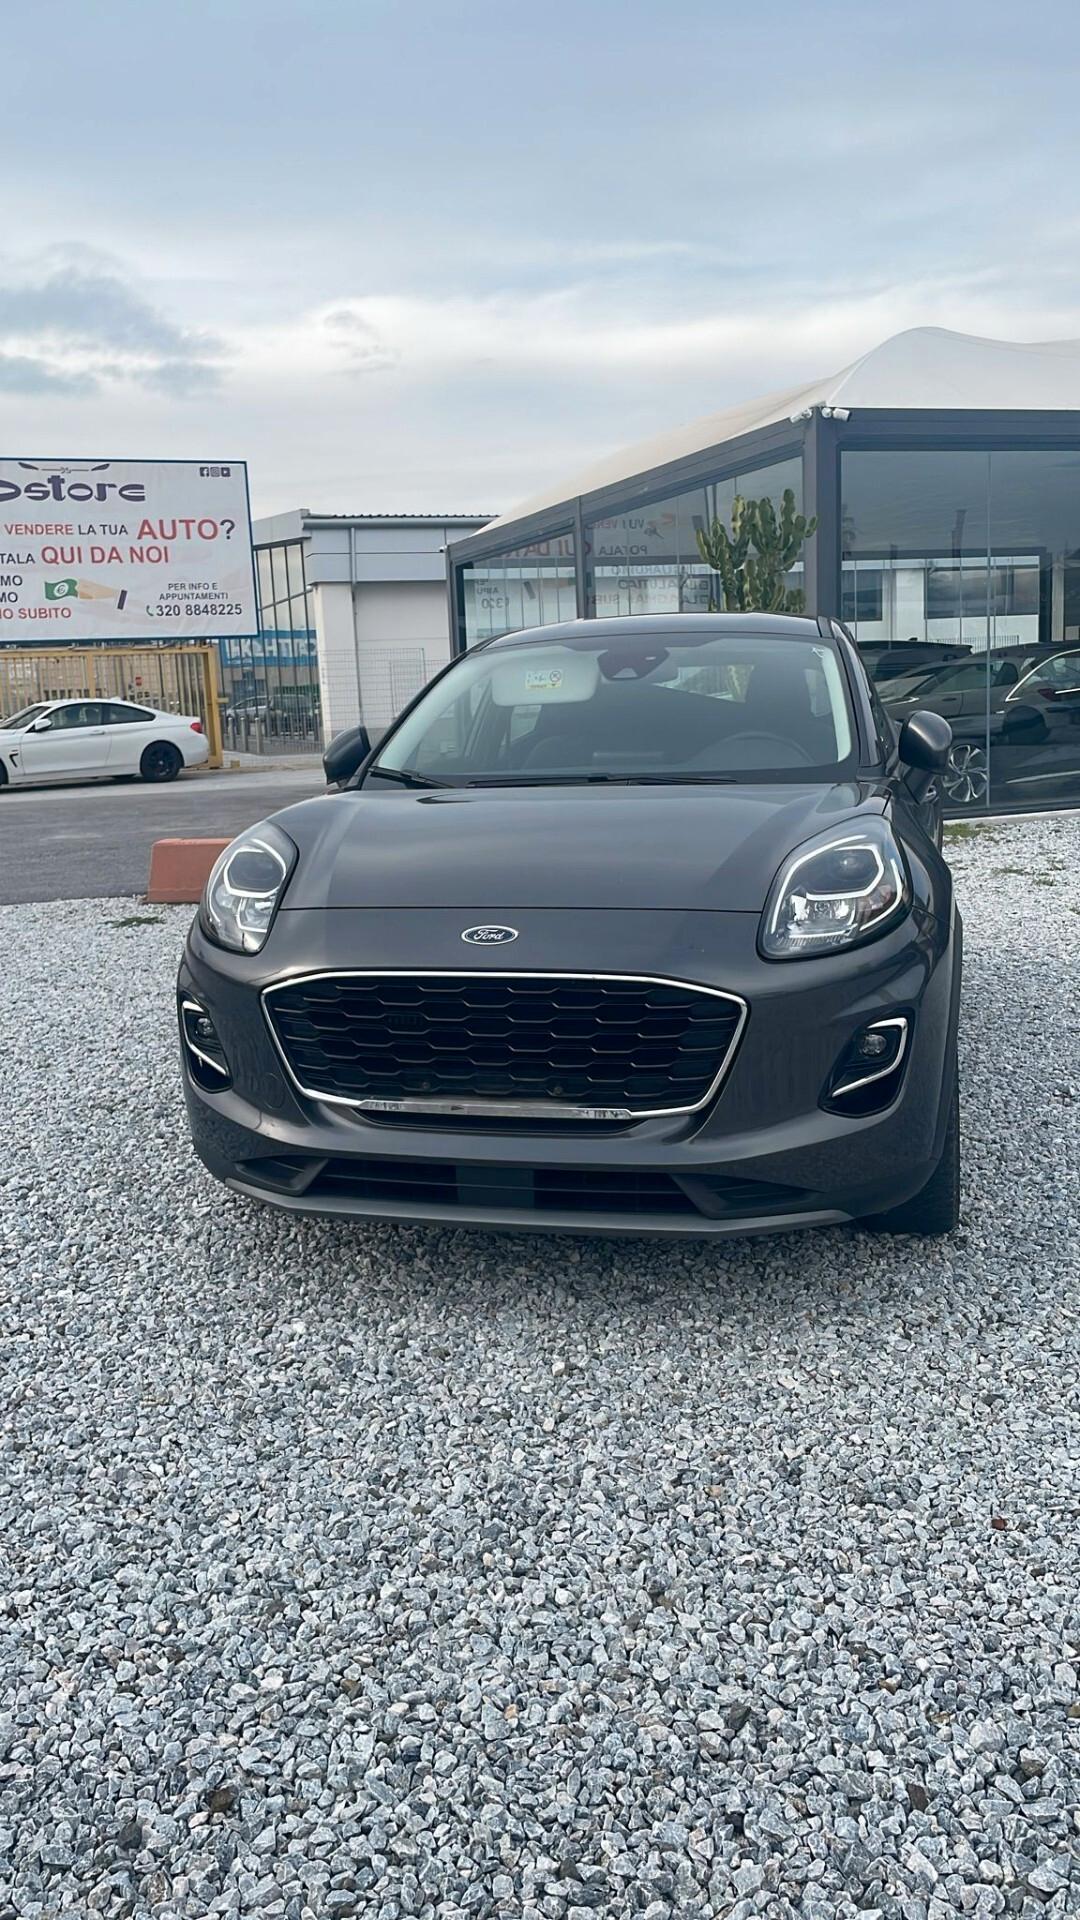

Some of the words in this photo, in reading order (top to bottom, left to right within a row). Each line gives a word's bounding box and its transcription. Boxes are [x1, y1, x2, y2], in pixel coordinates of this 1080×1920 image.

[4, 524, 74, 536] VENDERE
[78, 524, 97, 535] LA
[99, 524, 129, 536] TUA
[137, 518, 236, 540] AUTO?
[41, 545, 83, 566] QUI
[91, 546, 124, 564] DA
[129, 545, 169, 564] NOI
[168, 583, 187, 591] PER
[188, 583, 210, 591] INFO
[212, 582, 219, 591] E
[159, 592, 229, 601] APPUNTAMENTI
[18, 607, 72, 619] SUBITO
[156, 604, 181, 617] 320
[185, 603, 243, 616] 8848225
[473, 928, 506, 940] Ford
